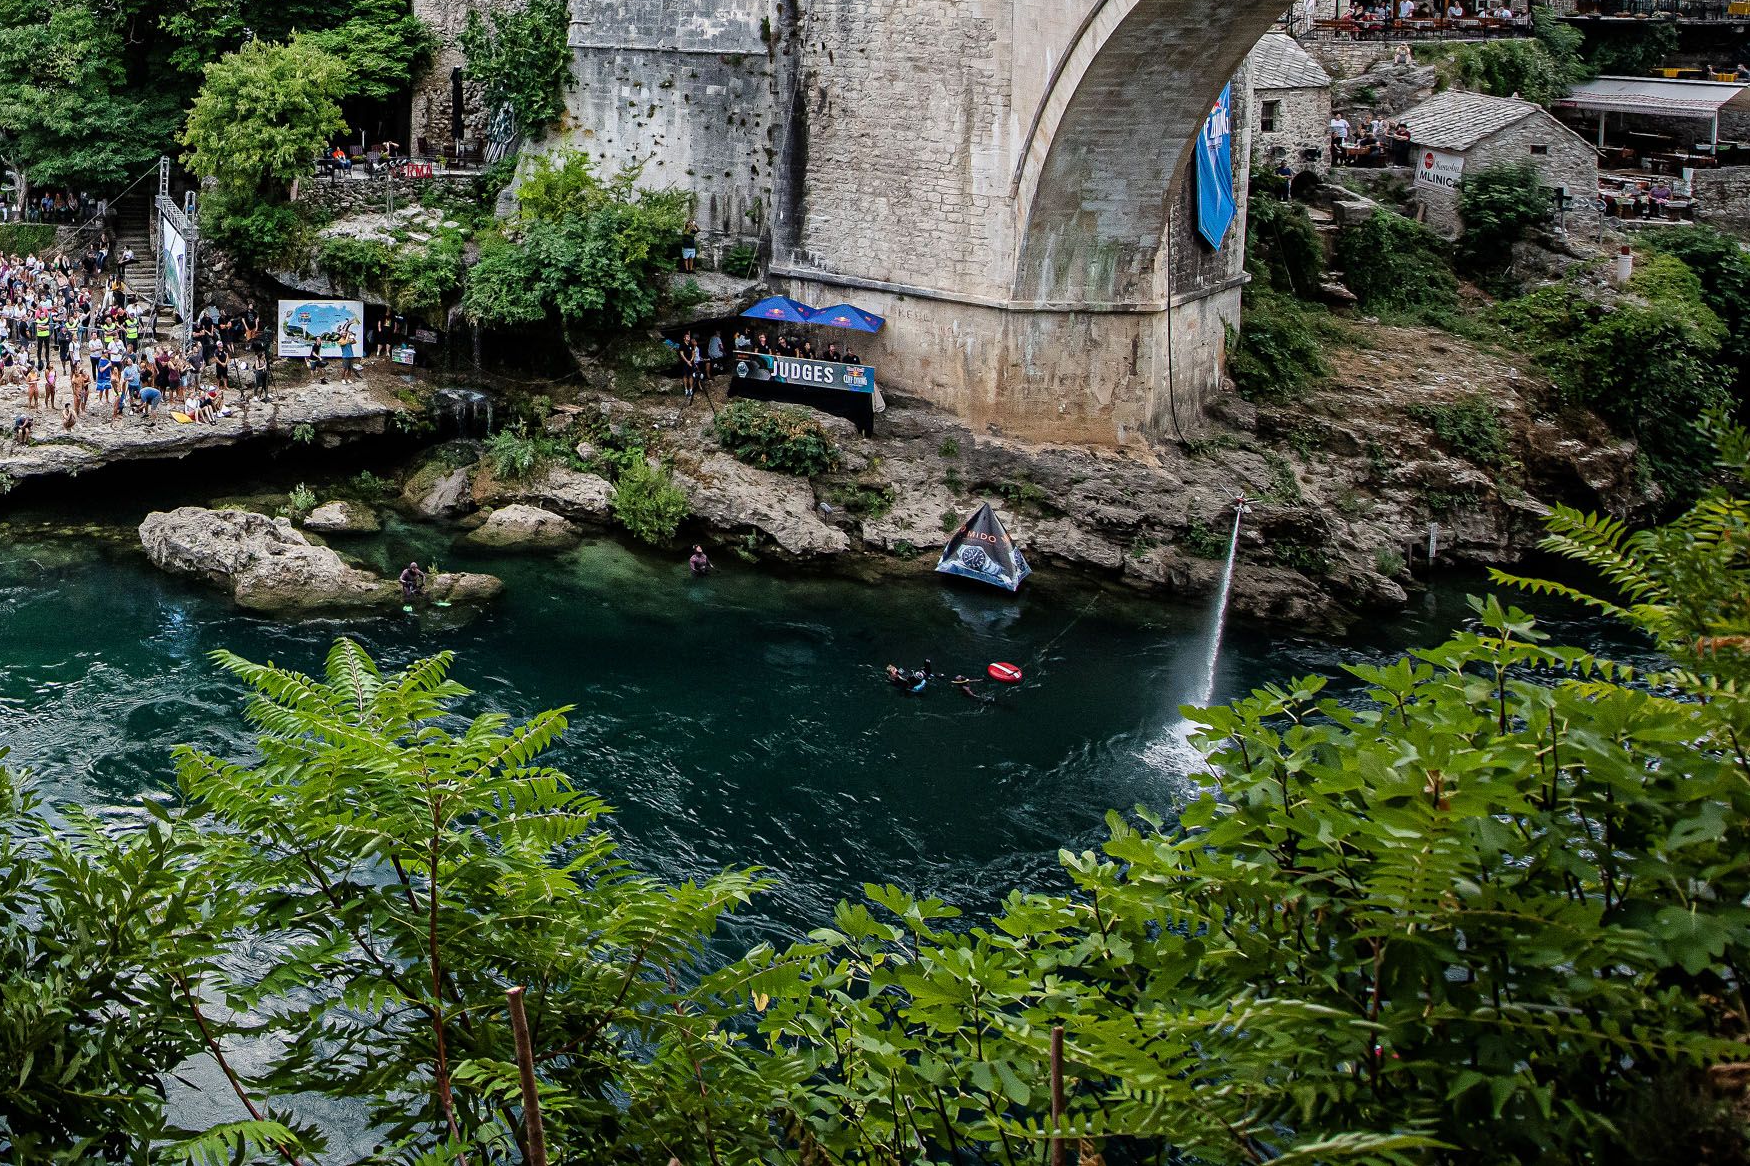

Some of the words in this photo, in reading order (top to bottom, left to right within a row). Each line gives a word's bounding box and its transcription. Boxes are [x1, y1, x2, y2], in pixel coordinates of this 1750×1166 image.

[1419, 170, 1457, 188] MLINIC
[771, 360, 835, 384] JUDGES
[967, 531, 997, 543] MIDO
